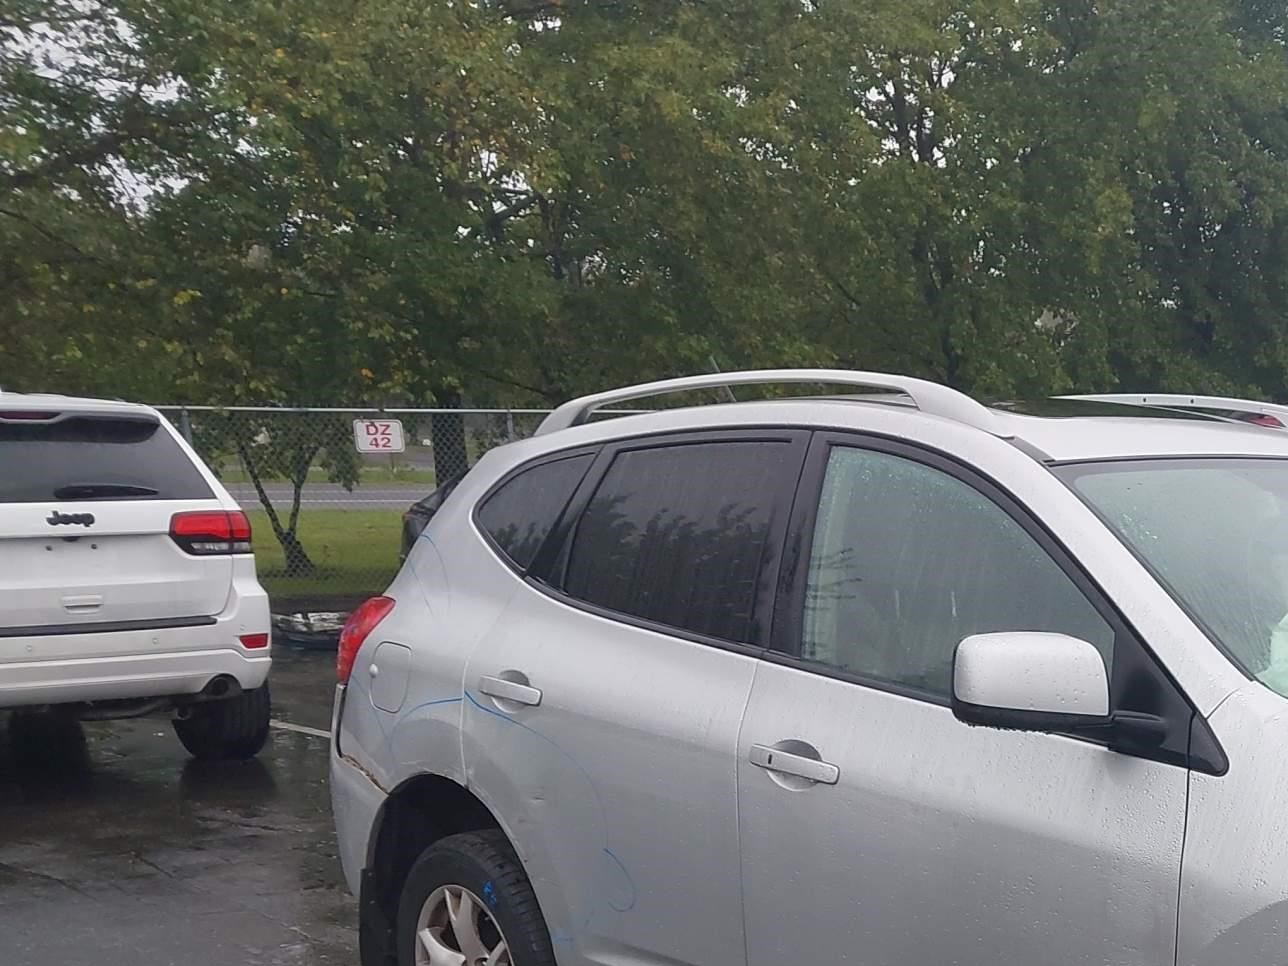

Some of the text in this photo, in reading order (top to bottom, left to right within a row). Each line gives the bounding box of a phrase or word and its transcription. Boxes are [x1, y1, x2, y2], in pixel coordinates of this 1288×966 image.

[365, 423, 392, 436] DZ
[369, 437, 392, 448] 42
[46, 510, 95, 528] Jeep
